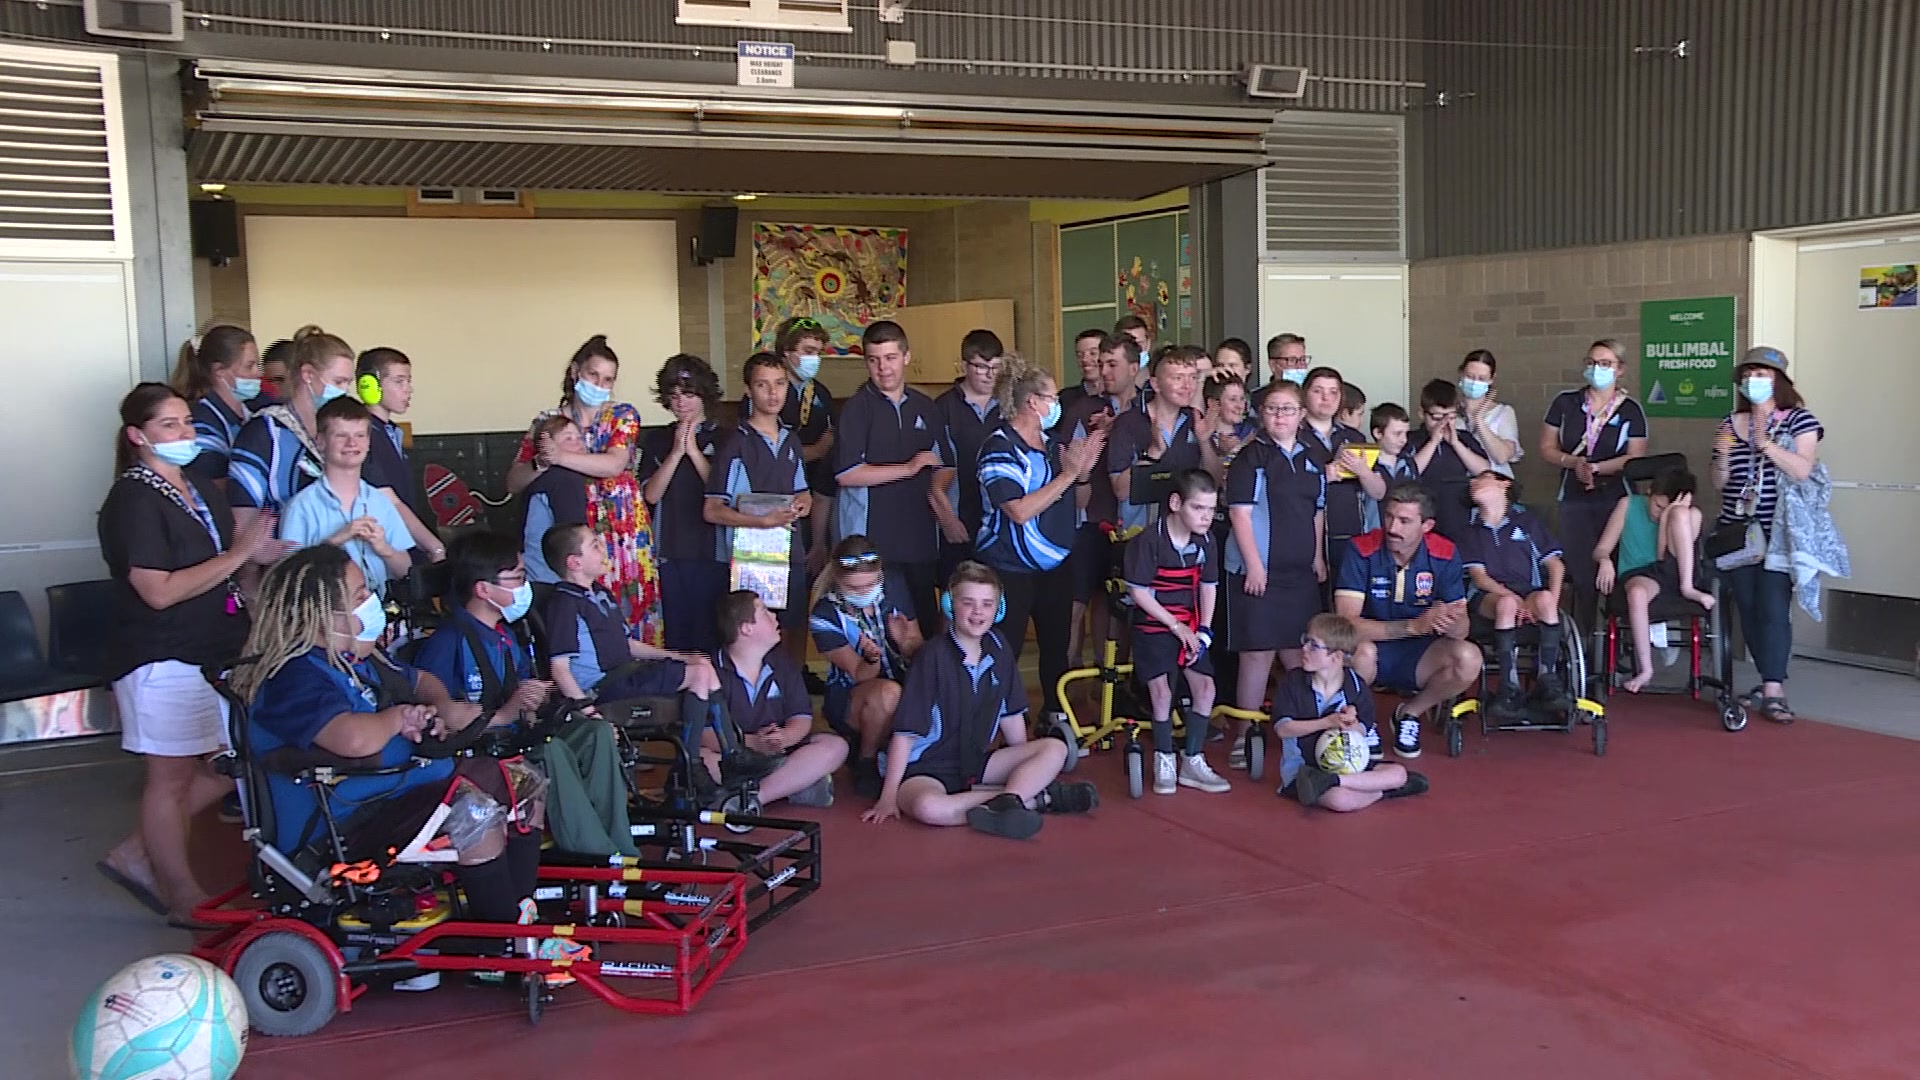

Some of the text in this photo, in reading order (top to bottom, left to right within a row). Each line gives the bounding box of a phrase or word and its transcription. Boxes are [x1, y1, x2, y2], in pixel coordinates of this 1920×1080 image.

[745, 45, 787, 56] NOTICE
[1669, 312, 1704, 321] WELCOME
[1646, 342, 1729, 357] BULLIMBAL
[1659, 359, 1716, 370] FRESH FOOD
